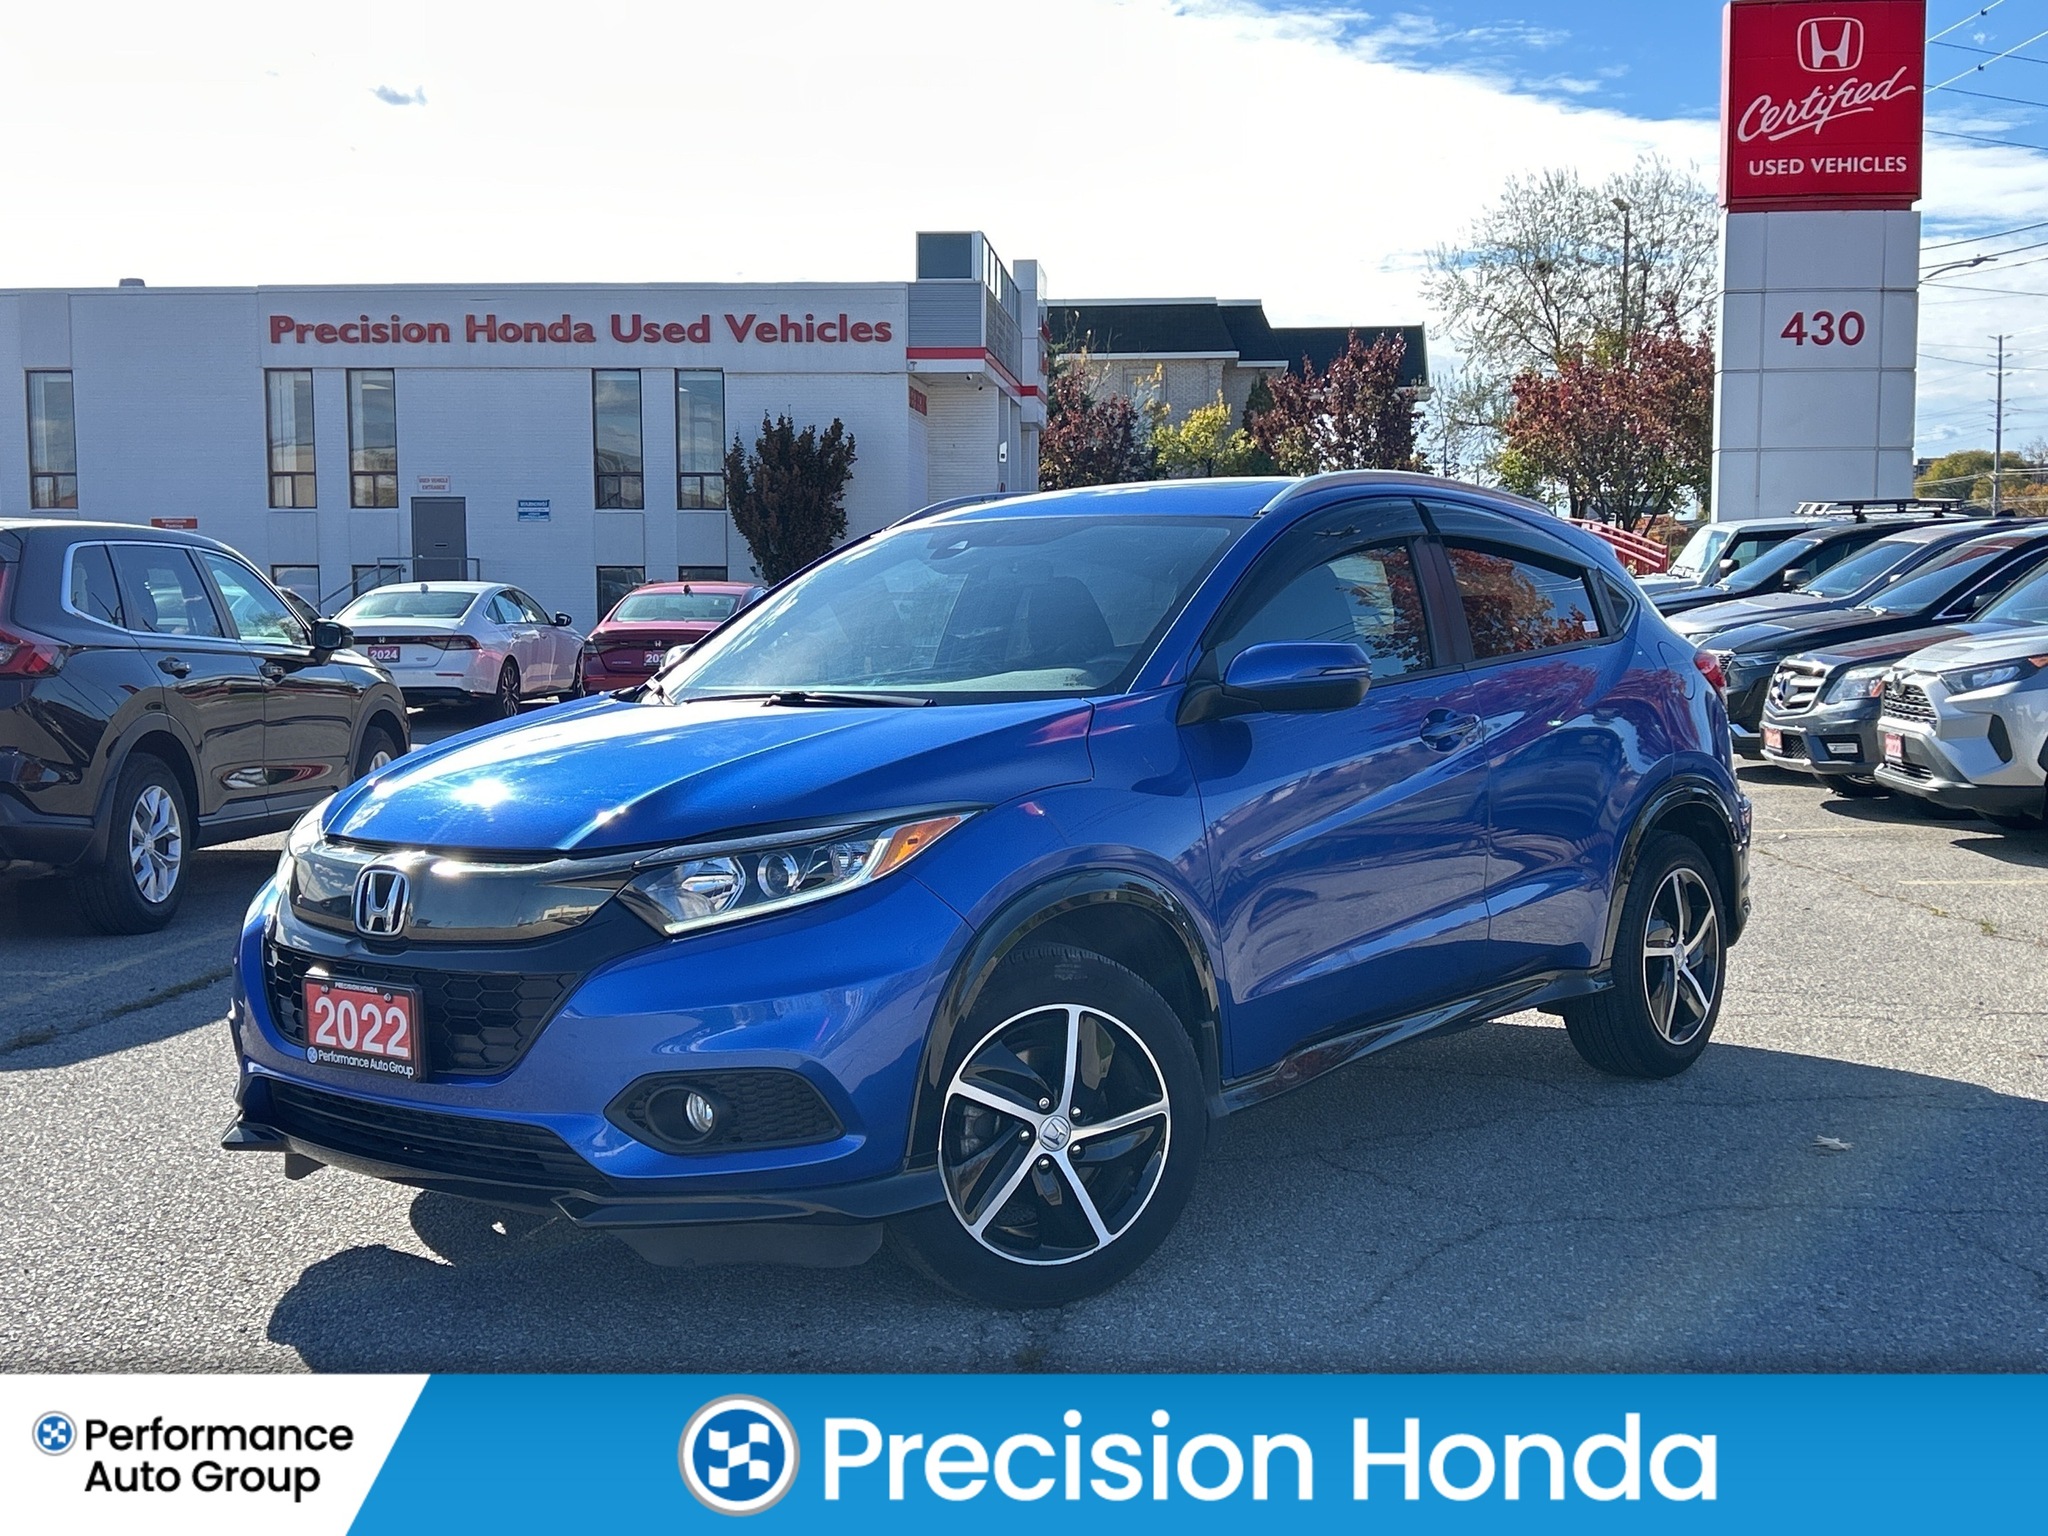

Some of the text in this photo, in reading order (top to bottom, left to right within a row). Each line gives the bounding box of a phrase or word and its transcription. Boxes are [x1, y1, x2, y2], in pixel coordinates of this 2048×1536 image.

[1737, 66, 1916, 142] Certified
[1749, 156, 1907, 176] USED VEHICLES
[269, 313, 893, 344] Precision Honda Used Vehicles
[1781, 310, 1865, 346] 430
[370, 649, 398, 660] 2024
[315, 996, 409, 1057] 2022
[318, 1050, 414, 1079] Performance Auto Group
